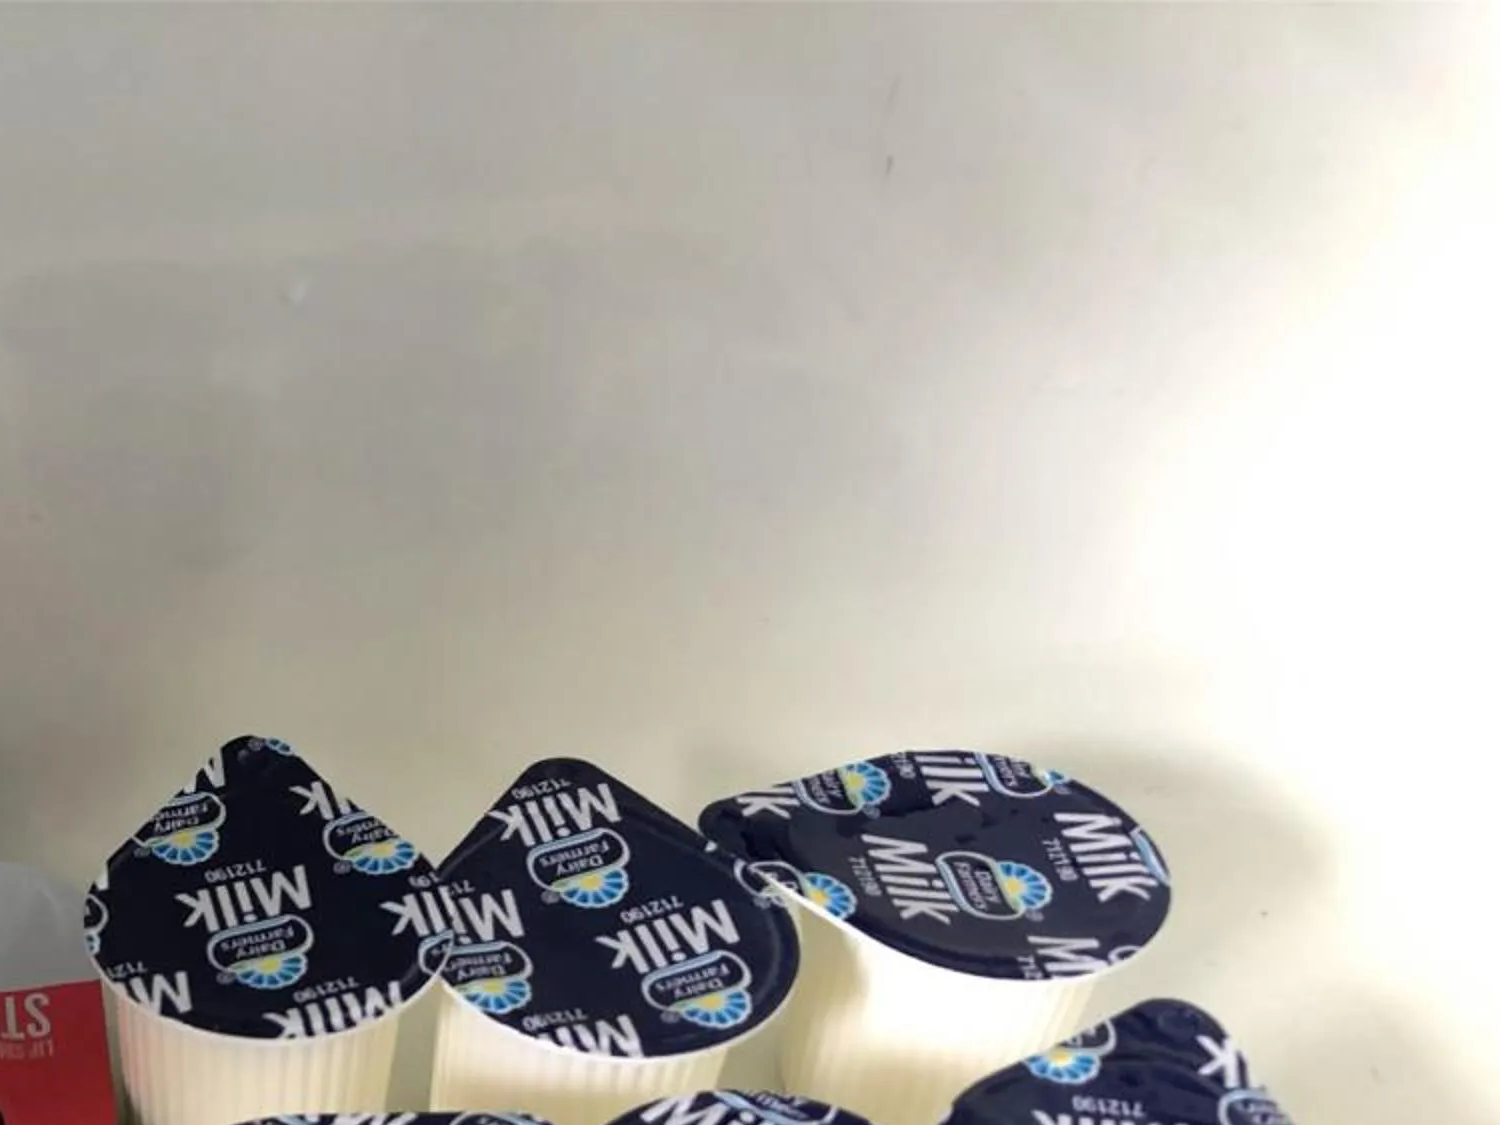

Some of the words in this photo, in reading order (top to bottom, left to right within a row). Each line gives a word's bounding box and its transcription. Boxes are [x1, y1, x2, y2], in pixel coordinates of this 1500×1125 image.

[914, 753, 989, 808] ilk
[487, 782, 622, 847] Milk
[540, 840, 610, 867] Farmers
[556, 854, 605, 877] Dairy
[1053, 812, 1158, 902] Milk
[205, 859, 267, 883] 712190
[860, 833, 961, 926] Milk
[174, 865, 313, 934] Milk
[620, 895, 684, 925] 712190
[220, 924, 295, 950] Farmers
[235, 941, 287, 959] Dairy
[595, 899, 740, 974] Milk
[656, 964, 732, 992] Farmers
[673, 979, 724, 999] Dairy
